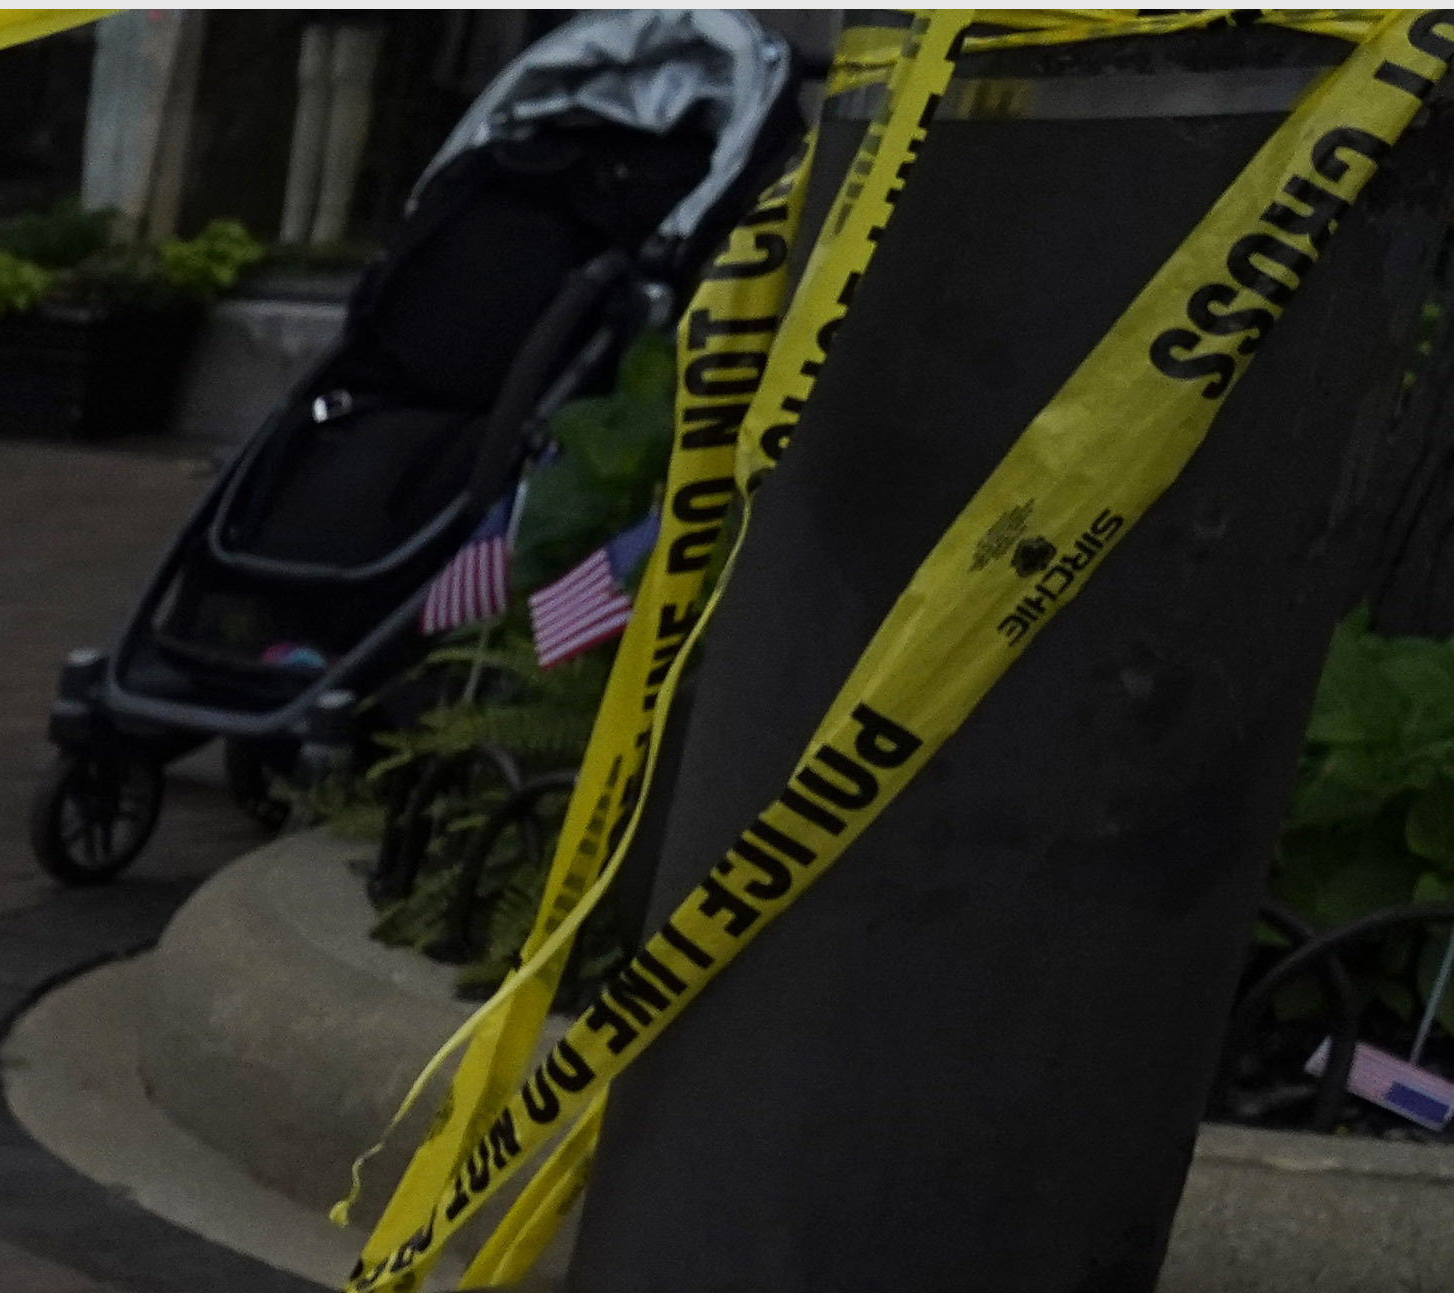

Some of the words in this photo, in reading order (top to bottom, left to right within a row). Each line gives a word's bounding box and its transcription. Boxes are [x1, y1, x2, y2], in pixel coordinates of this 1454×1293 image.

[1140, 120, 1394, 402] CROSS
[678, 305, 778, 447] NOT
[663, 476, 736, 570] DO
[997, 507, 1125, 647] SIRCHIE
[687, 698, 923, 942] POLICE
[578, 921, 715, 1058] LINE
[515, 1037, 598, 1131] DO
[450, 1107, 525, 1223] NOT
